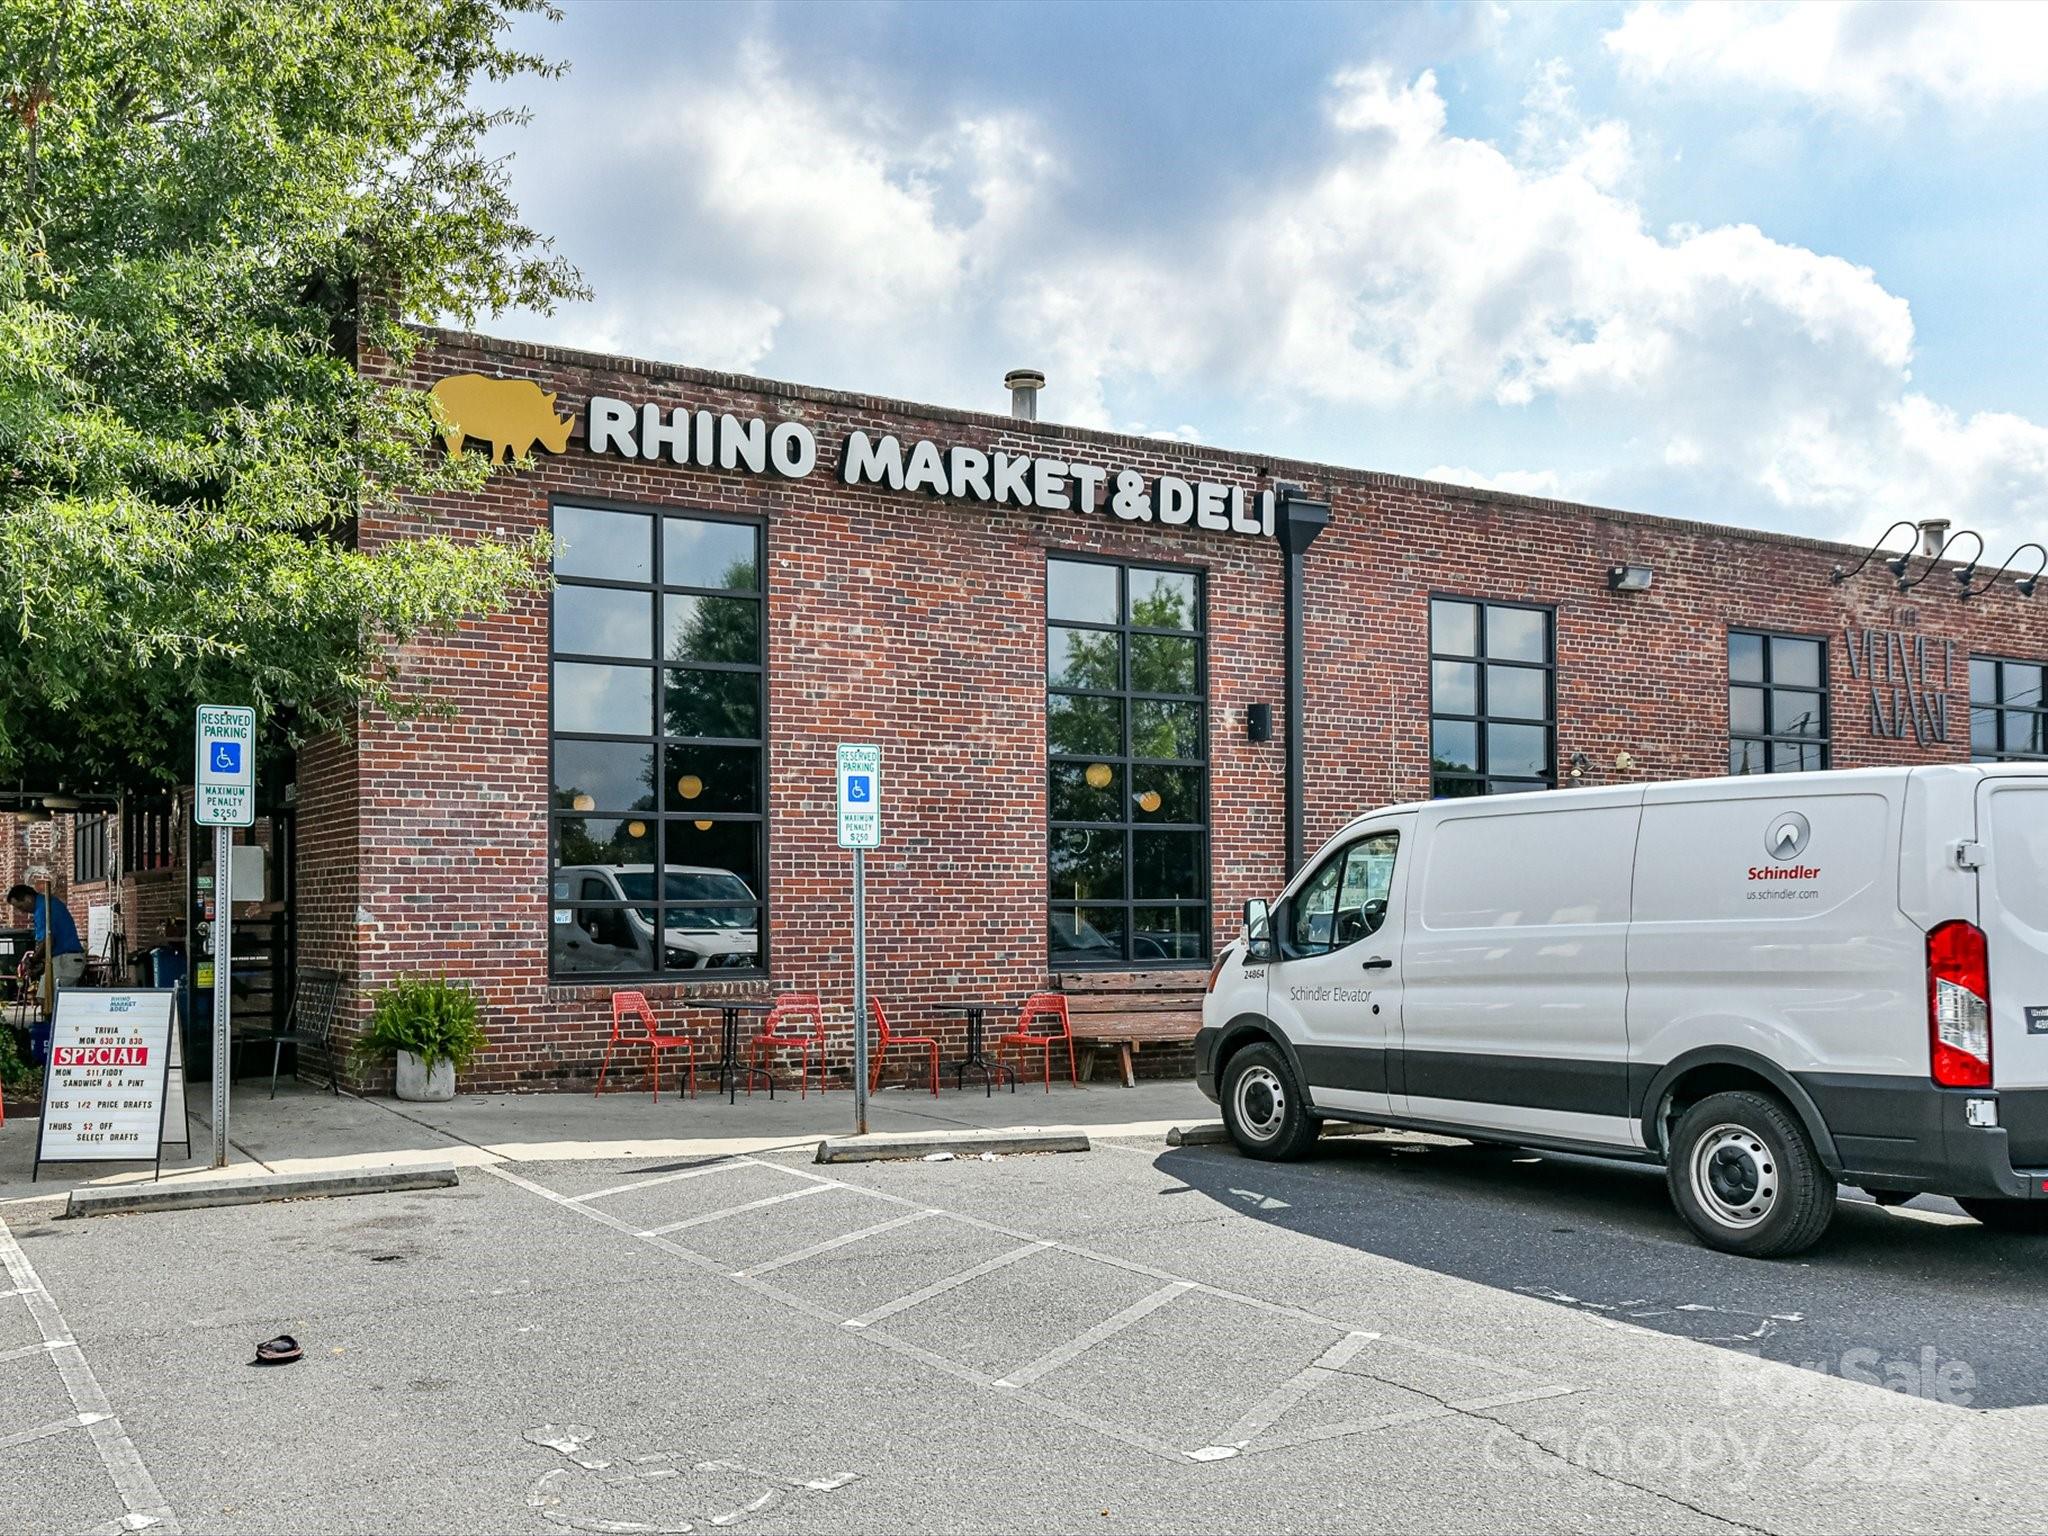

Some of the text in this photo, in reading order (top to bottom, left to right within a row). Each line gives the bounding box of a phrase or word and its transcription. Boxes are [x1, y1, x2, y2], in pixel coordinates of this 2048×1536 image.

[588, 396, 817, 478] RHINO
[843, 430, 1107, 514] MARKET
[1159, 476, 1275, 537] DELI
[201, 713, 251, 726] RESERVED
[204, 726, 248, 739] PARKING
[840, 751, 877, 761] RESERVED
[843, 762, 875, 772] PARKING
[205, 786, 245, 796] MAXIMUM
[207, 797, 242, 806] PENALTY
[212, 808, 237, 818] $250
[845, 823, 872, 831] PENALTY
[850, 833, 869, 841] $250
[1747, 865, 1821, 880] Schindler
[1746, 889, 1819, 900] us.schindler.com
[1290, 986, 1373, 1002] Schindler Elevator
[95, 1026, 119, 1034] TRIVIA
[79, 1037, 96, 1045] MON
[116, 1037, 126, 1045] TO
[58, 1048, 143, 1065] SPECIAL
[55, 1069, 72, 1077] MON
[63, 1079, 102, 1087] SANDWICH
[127, 1079, 145, 1087] PINT
[50, 1100, 153, 1109] TUES 1/2 PRICE DRAFTS
[48, 1122, 113, 1130] THURS $2 OFF
[76, 1133, 139, 1141] SELECT DRAFTS
